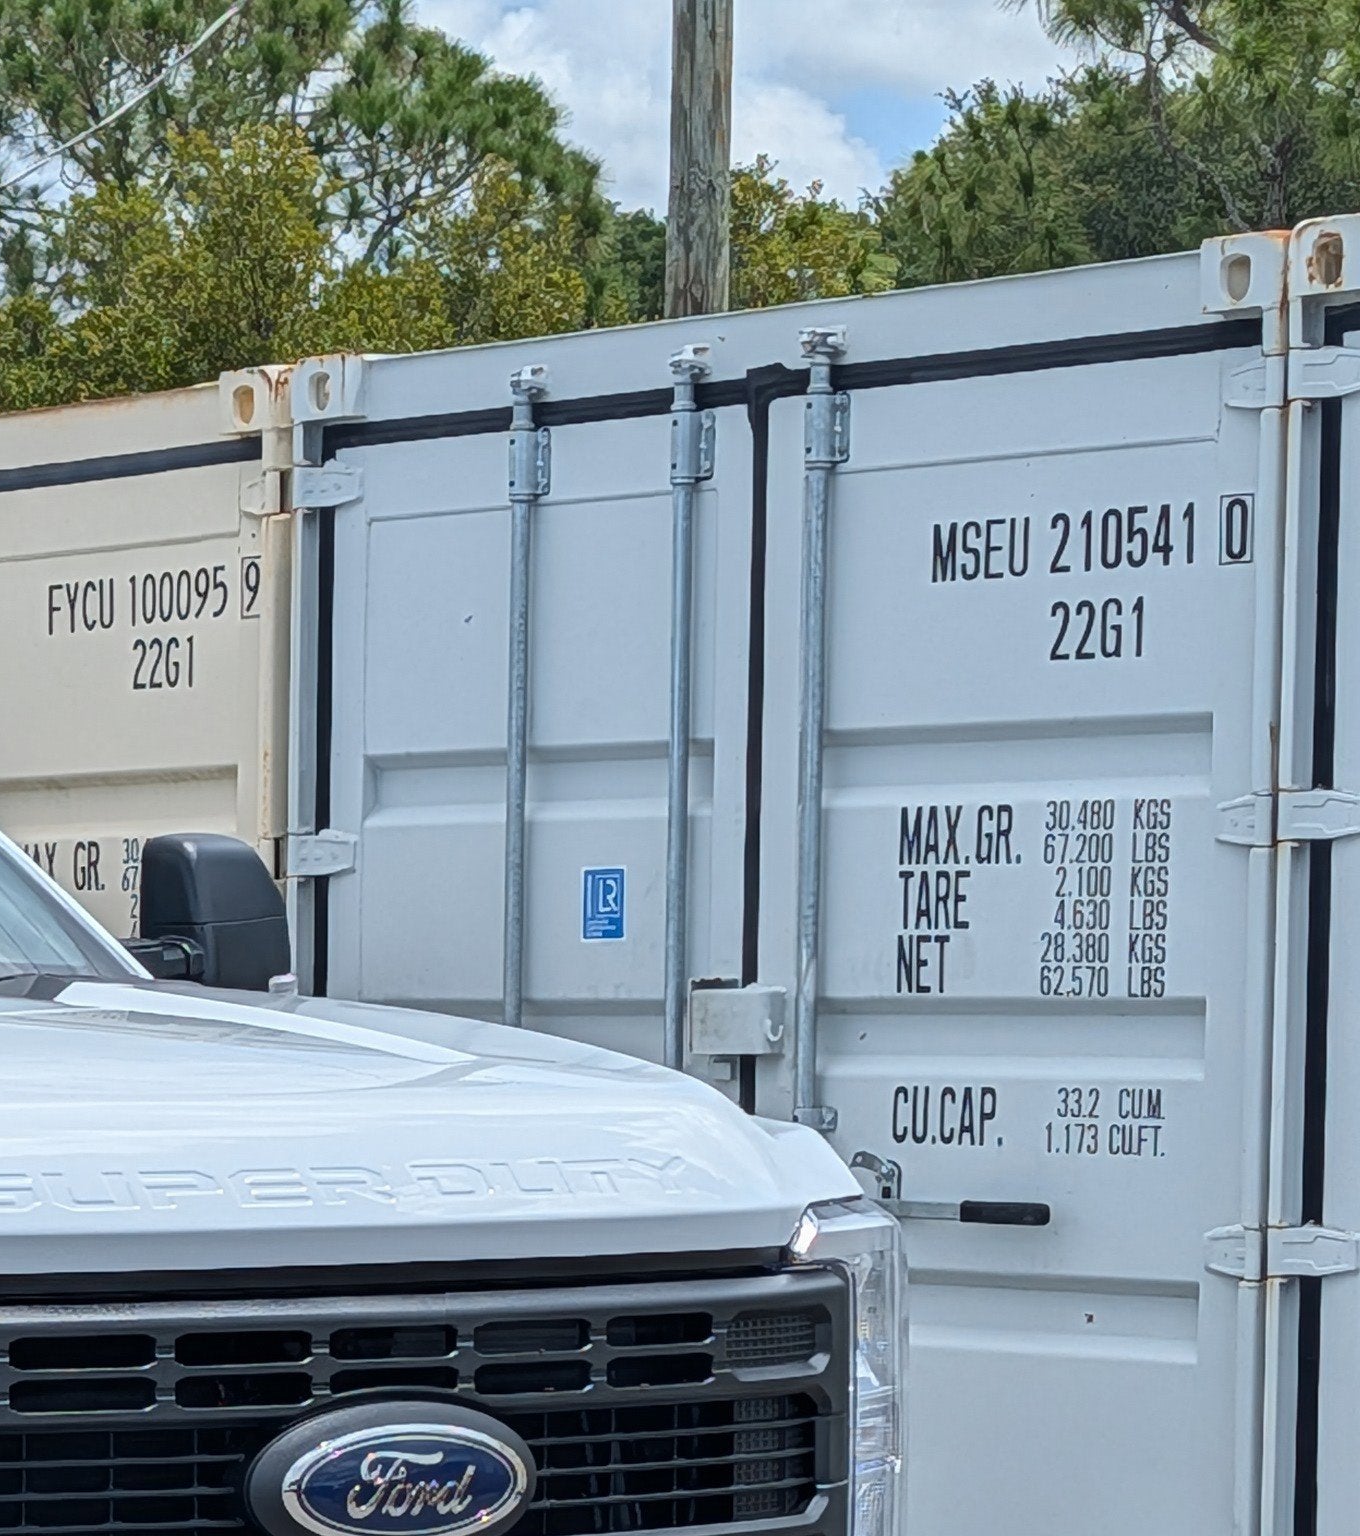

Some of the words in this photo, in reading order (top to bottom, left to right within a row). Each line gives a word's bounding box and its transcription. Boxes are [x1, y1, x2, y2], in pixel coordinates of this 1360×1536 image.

[931, 516, 1030, 584] MSEU
[1049, 501, 1195, 574] 210541
[1225, 496, 1249, 561] 0
[48, 577, 115, 636] FYCU
[128, 564, 228, 627] 100095
[244, 561, 260, 614] 9
[1049, 595, 1144, 661] 22G1
[132, 635, 194, 690] 22G1
[1132, 798, 1172, 831] KGS
[73, 840, 105, 891] GR.
[1131, 831, 1170, 864] LBS
[898, 869, 971, 931] TARE
[1129, 865, 1169, 898] KGS
[1128, 898, 1168, 931] LBS
[896, 934, 951, 994] NET
[1128, 932, 1167, 965] KGS
[1127, 965, 1166, 998] LBS
[404, 1155, 684, 1202] DUTY
[345, 1449, 477, 1522] Ford
